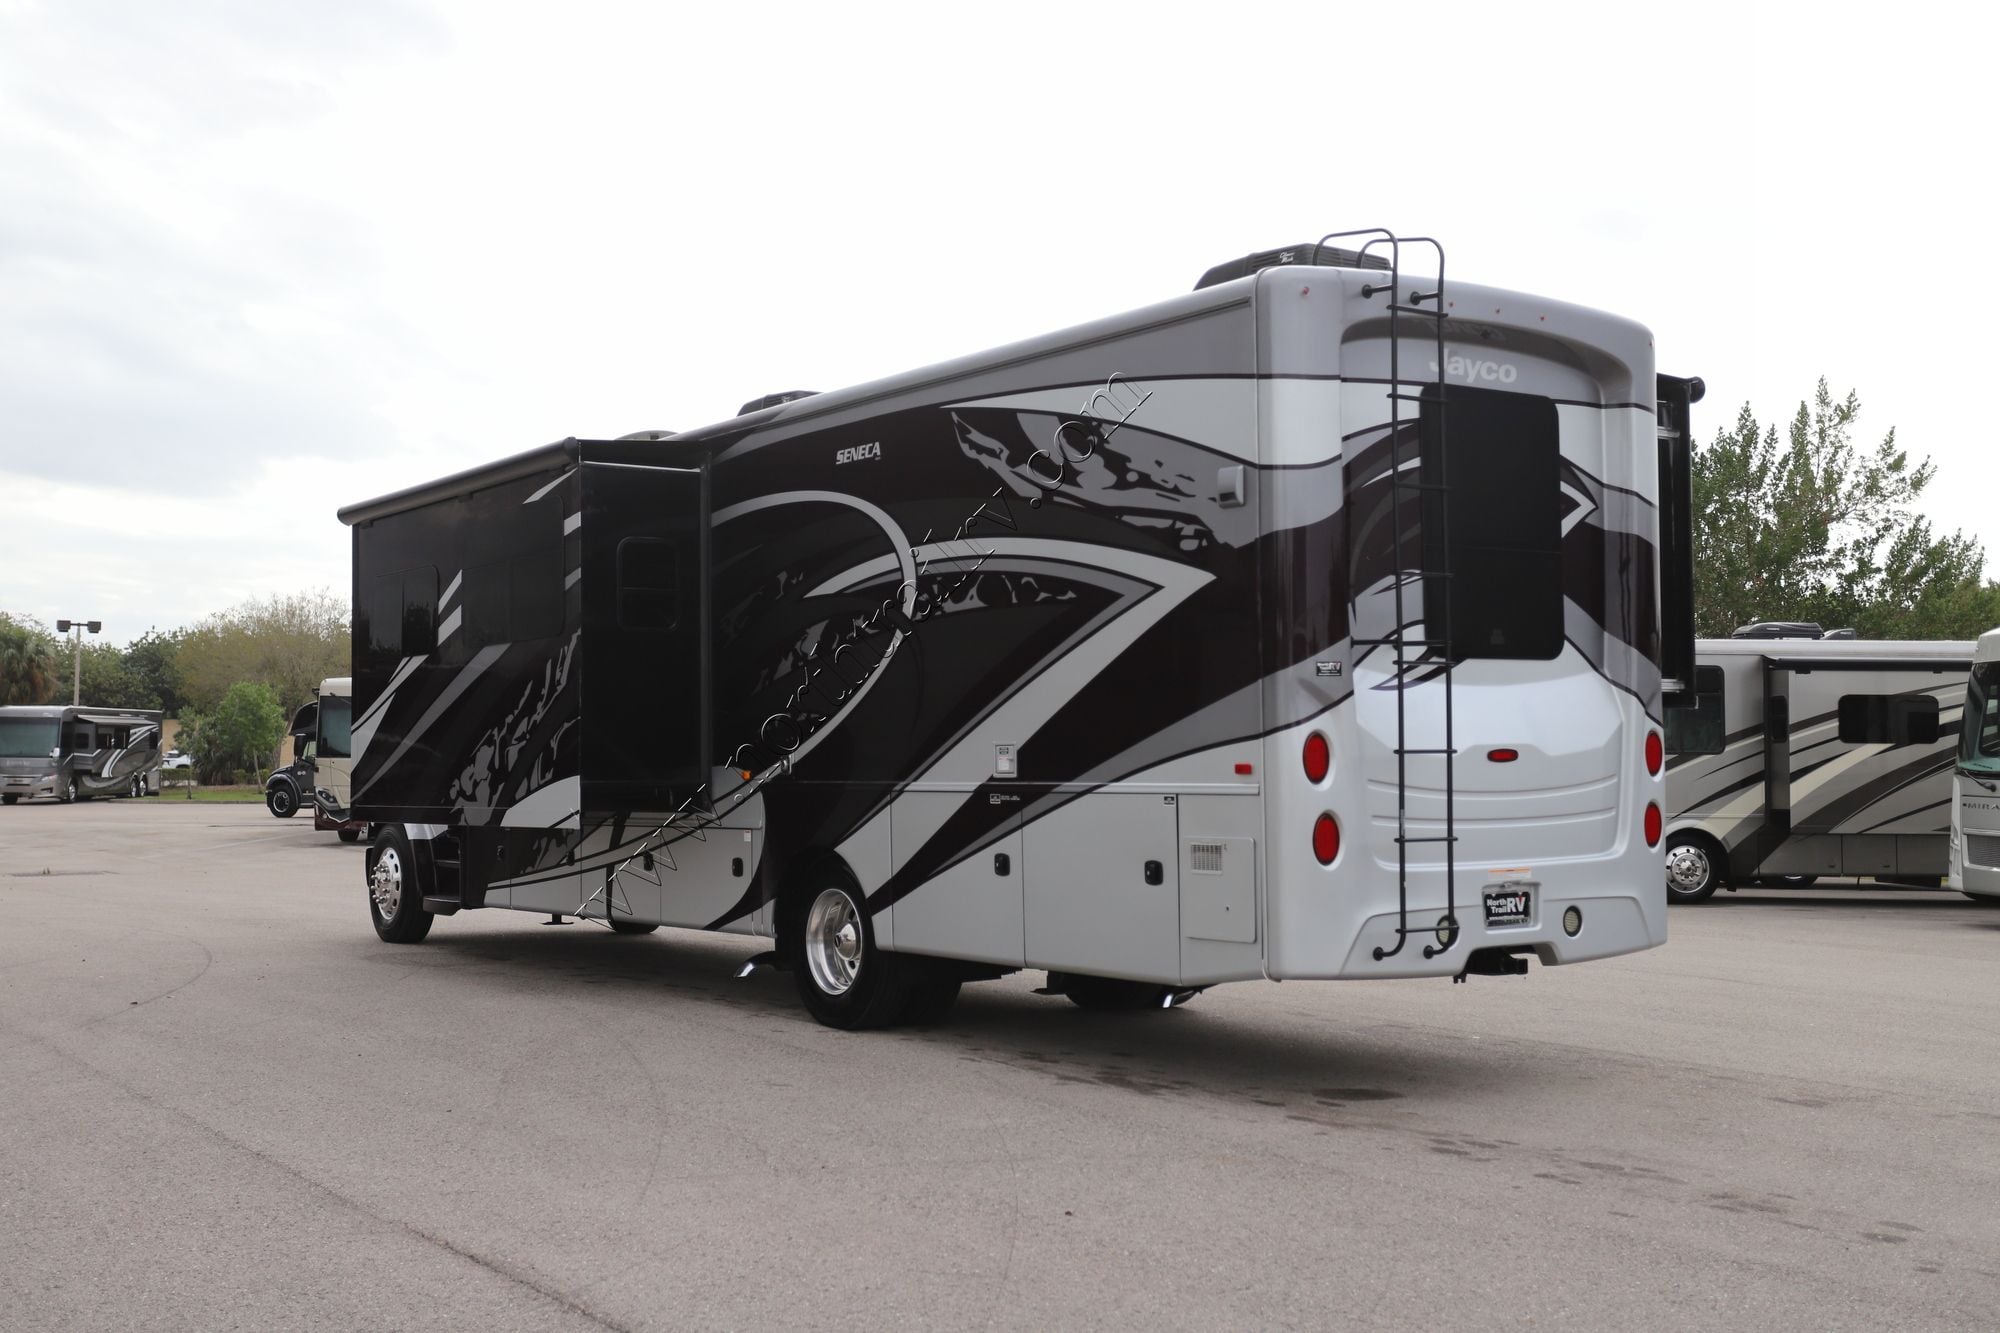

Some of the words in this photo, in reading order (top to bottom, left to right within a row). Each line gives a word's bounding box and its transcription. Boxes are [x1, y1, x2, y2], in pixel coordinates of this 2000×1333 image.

[1428, 347, 1518, 384] Jayco
[836, 441, 881, 465] SENECA
[1487, 898, 1506, 906] North
[1506, 897, 1525, 912] RV
